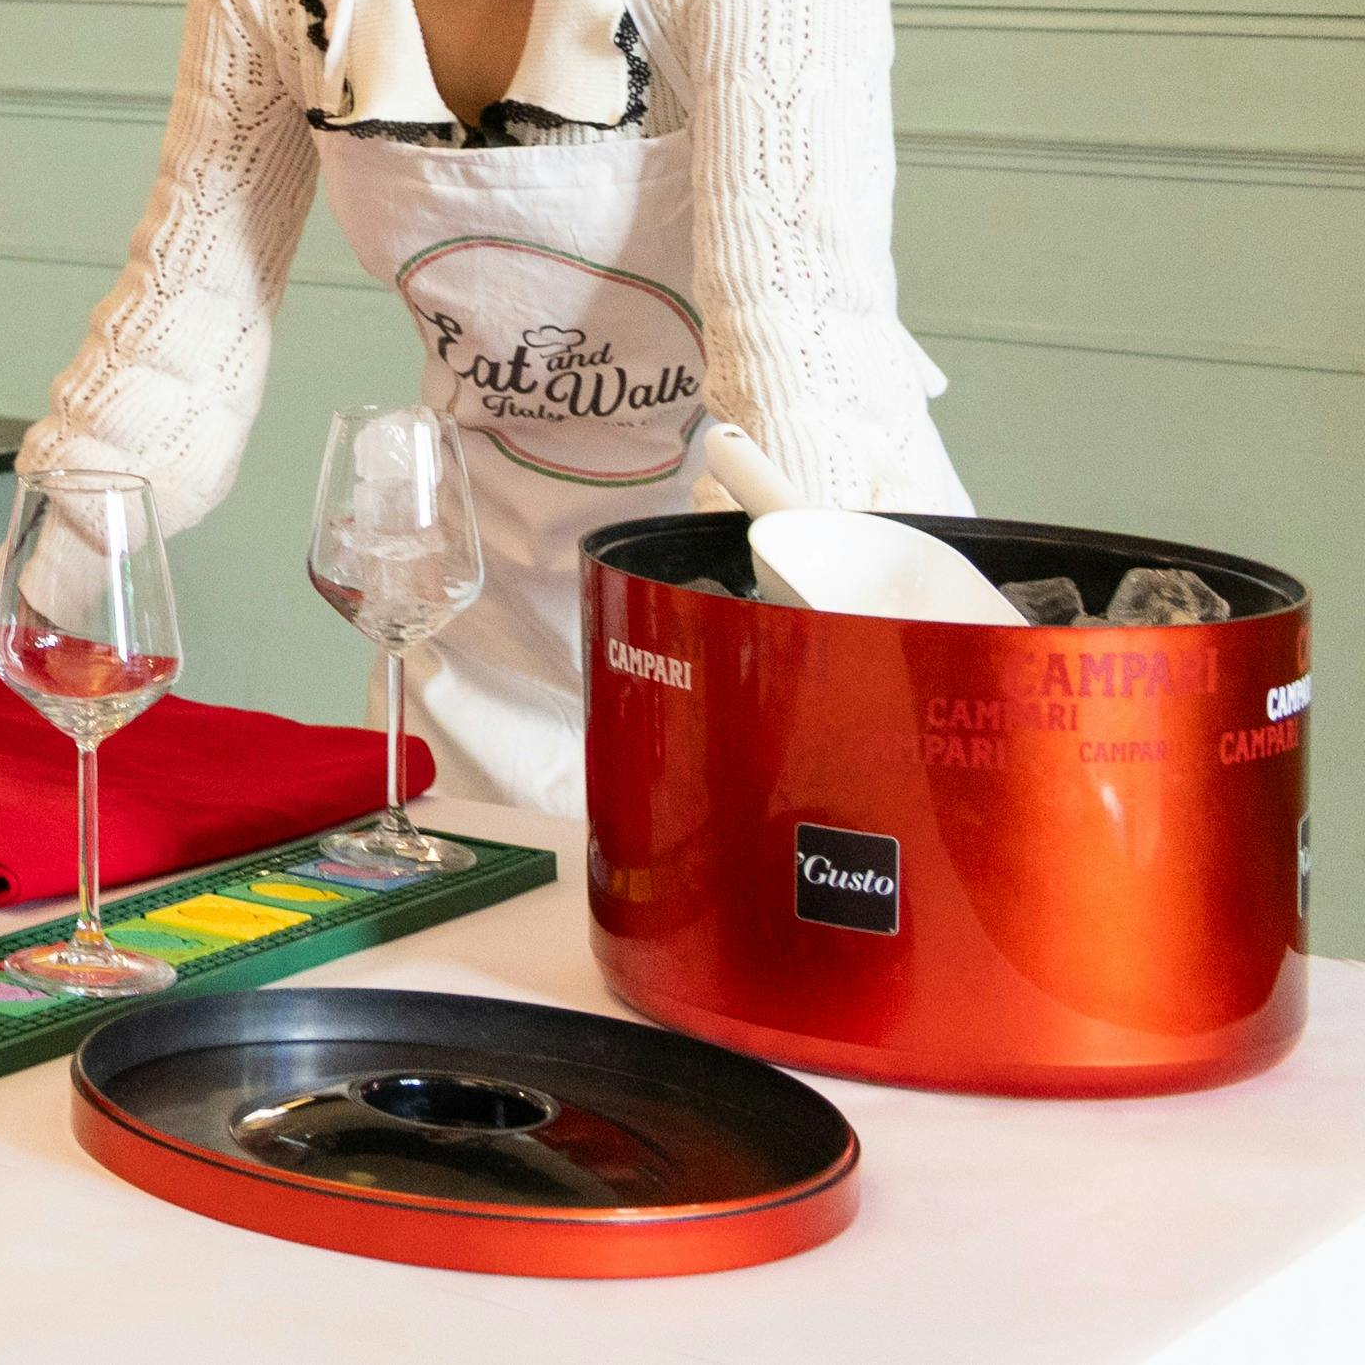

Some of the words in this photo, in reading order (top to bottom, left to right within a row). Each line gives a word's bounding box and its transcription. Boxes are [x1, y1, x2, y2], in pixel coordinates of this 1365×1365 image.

[414, 304, 539, 395] Eat
[546, 342, 613, 372] and
[545, 365, 700, 418] Walk
[608, 637, 693, 691] CAMPARI
[1002, 647, 1219, 699] CAMPARI
[925, 699, 1078, 732] CAMPARI
